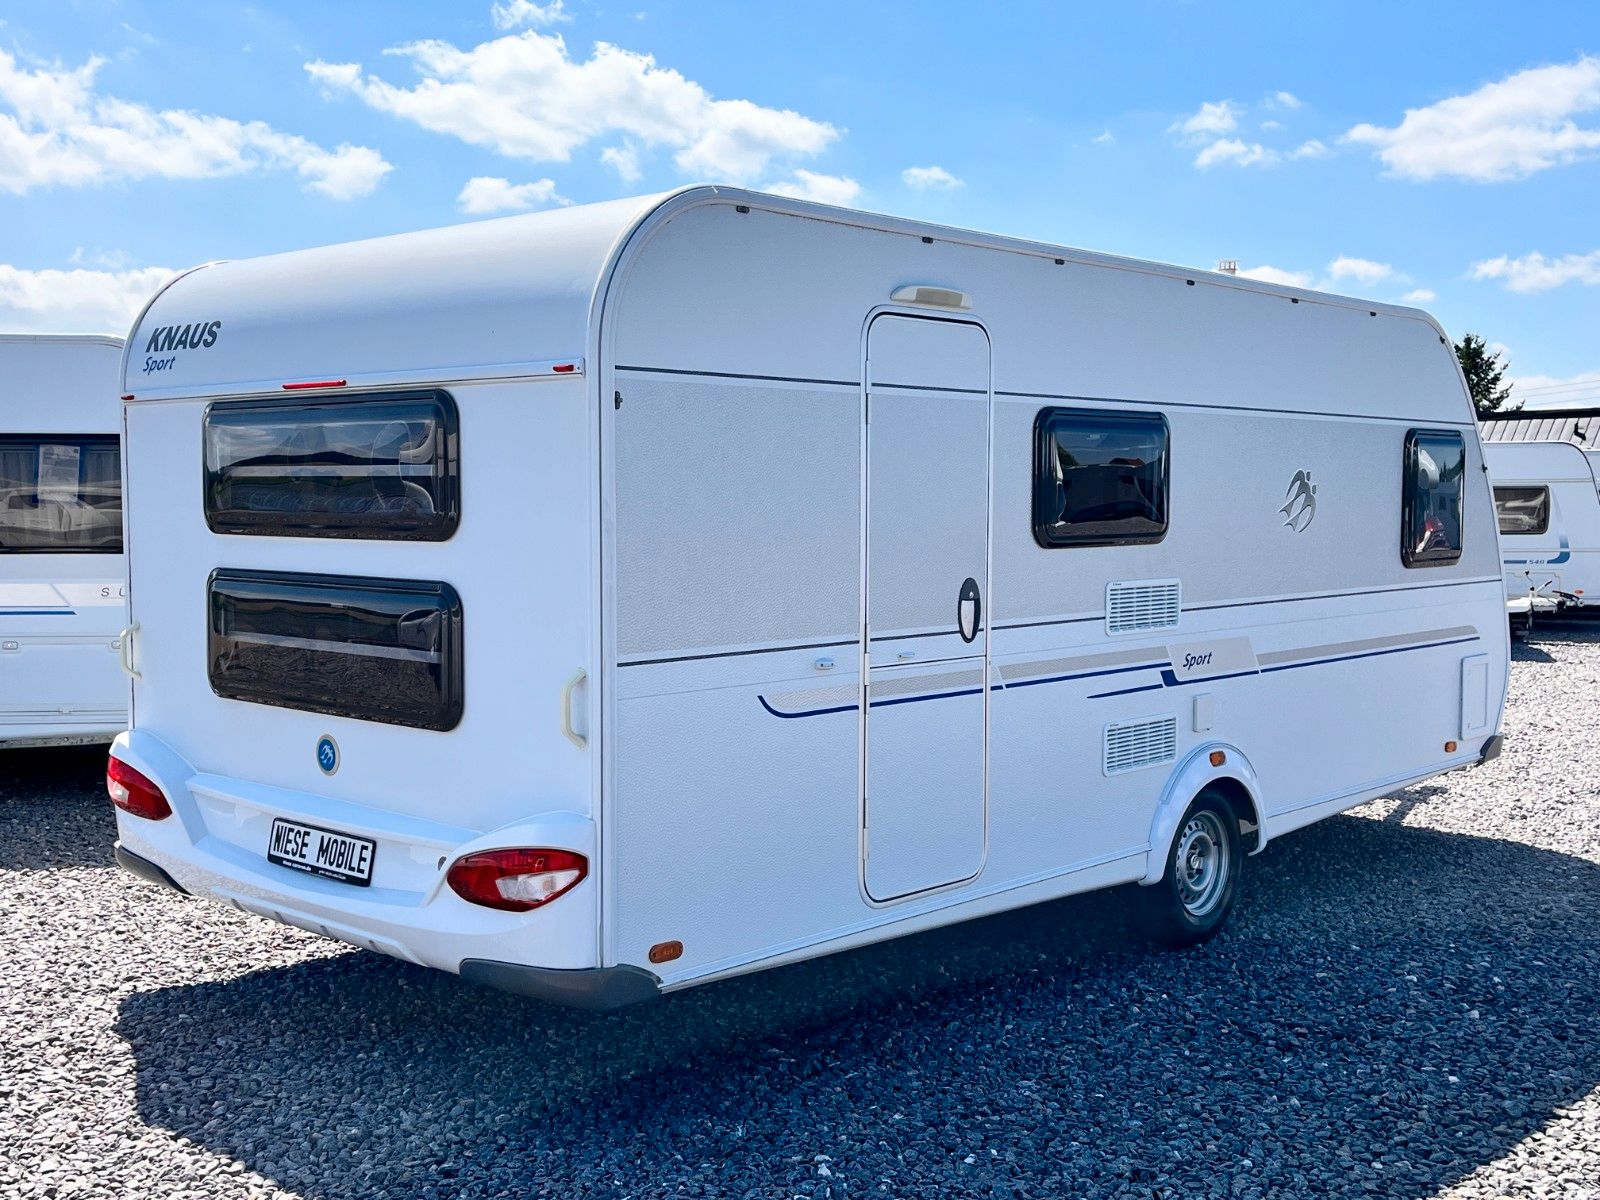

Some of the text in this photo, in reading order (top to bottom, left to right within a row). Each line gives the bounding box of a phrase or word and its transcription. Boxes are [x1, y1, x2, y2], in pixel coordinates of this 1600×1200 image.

[145, 320, 222, 353] KNAUS
[142, 356, 176, 376] Sport
[1182, 652, 1212, 671] Sport
[316, 835, 369, 875] MOBILE
